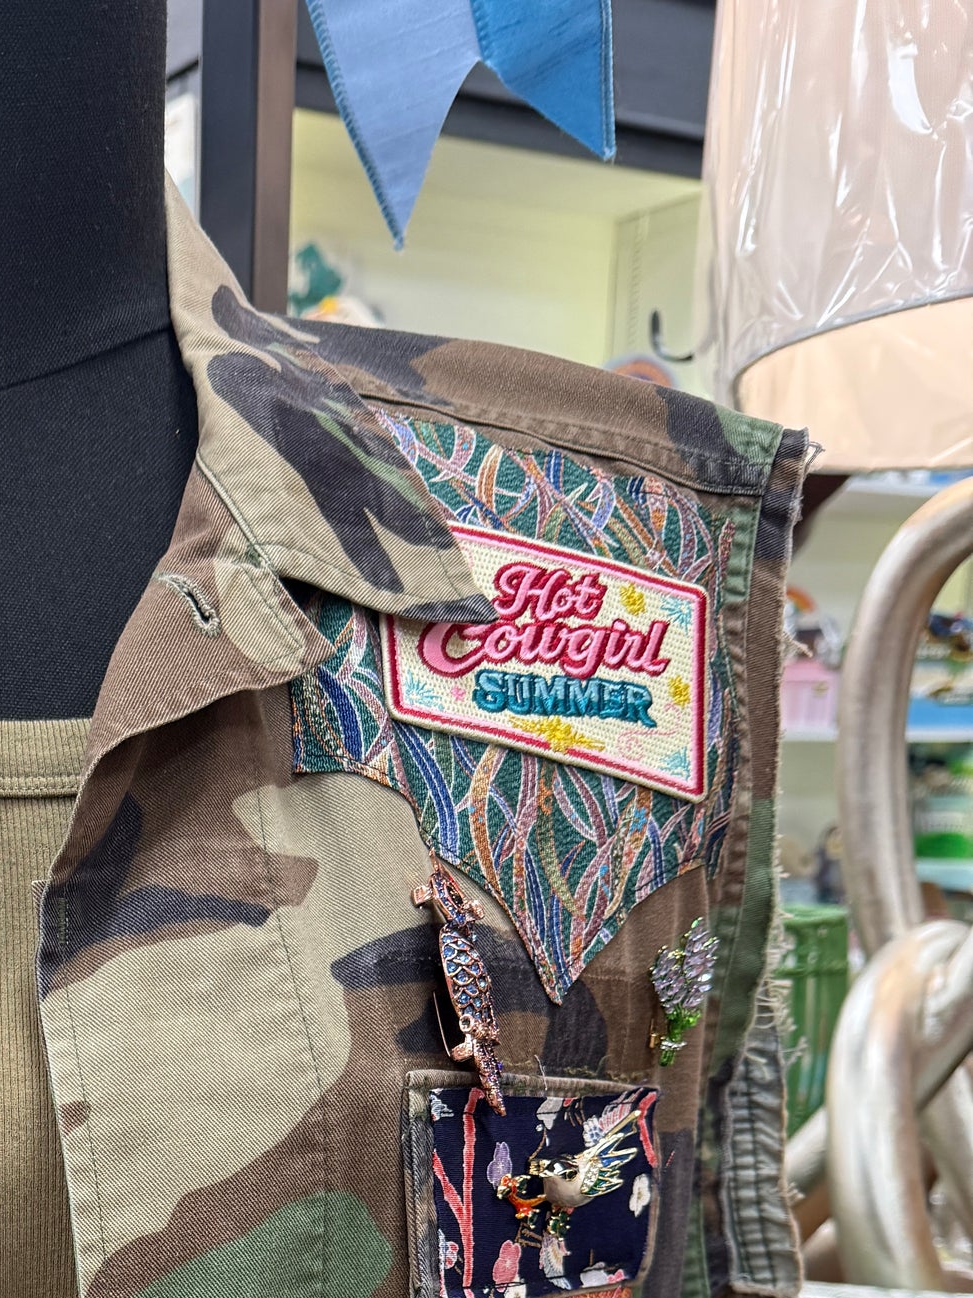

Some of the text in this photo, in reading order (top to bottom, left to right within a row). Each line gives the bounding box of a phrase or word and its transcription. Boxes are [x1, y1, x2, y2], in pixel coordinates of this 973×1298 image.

[493, 562, 607, 622] Hot
[418, 618, 670, 679] Cowgirl
[473, 670, 657, 728] SUMMER
